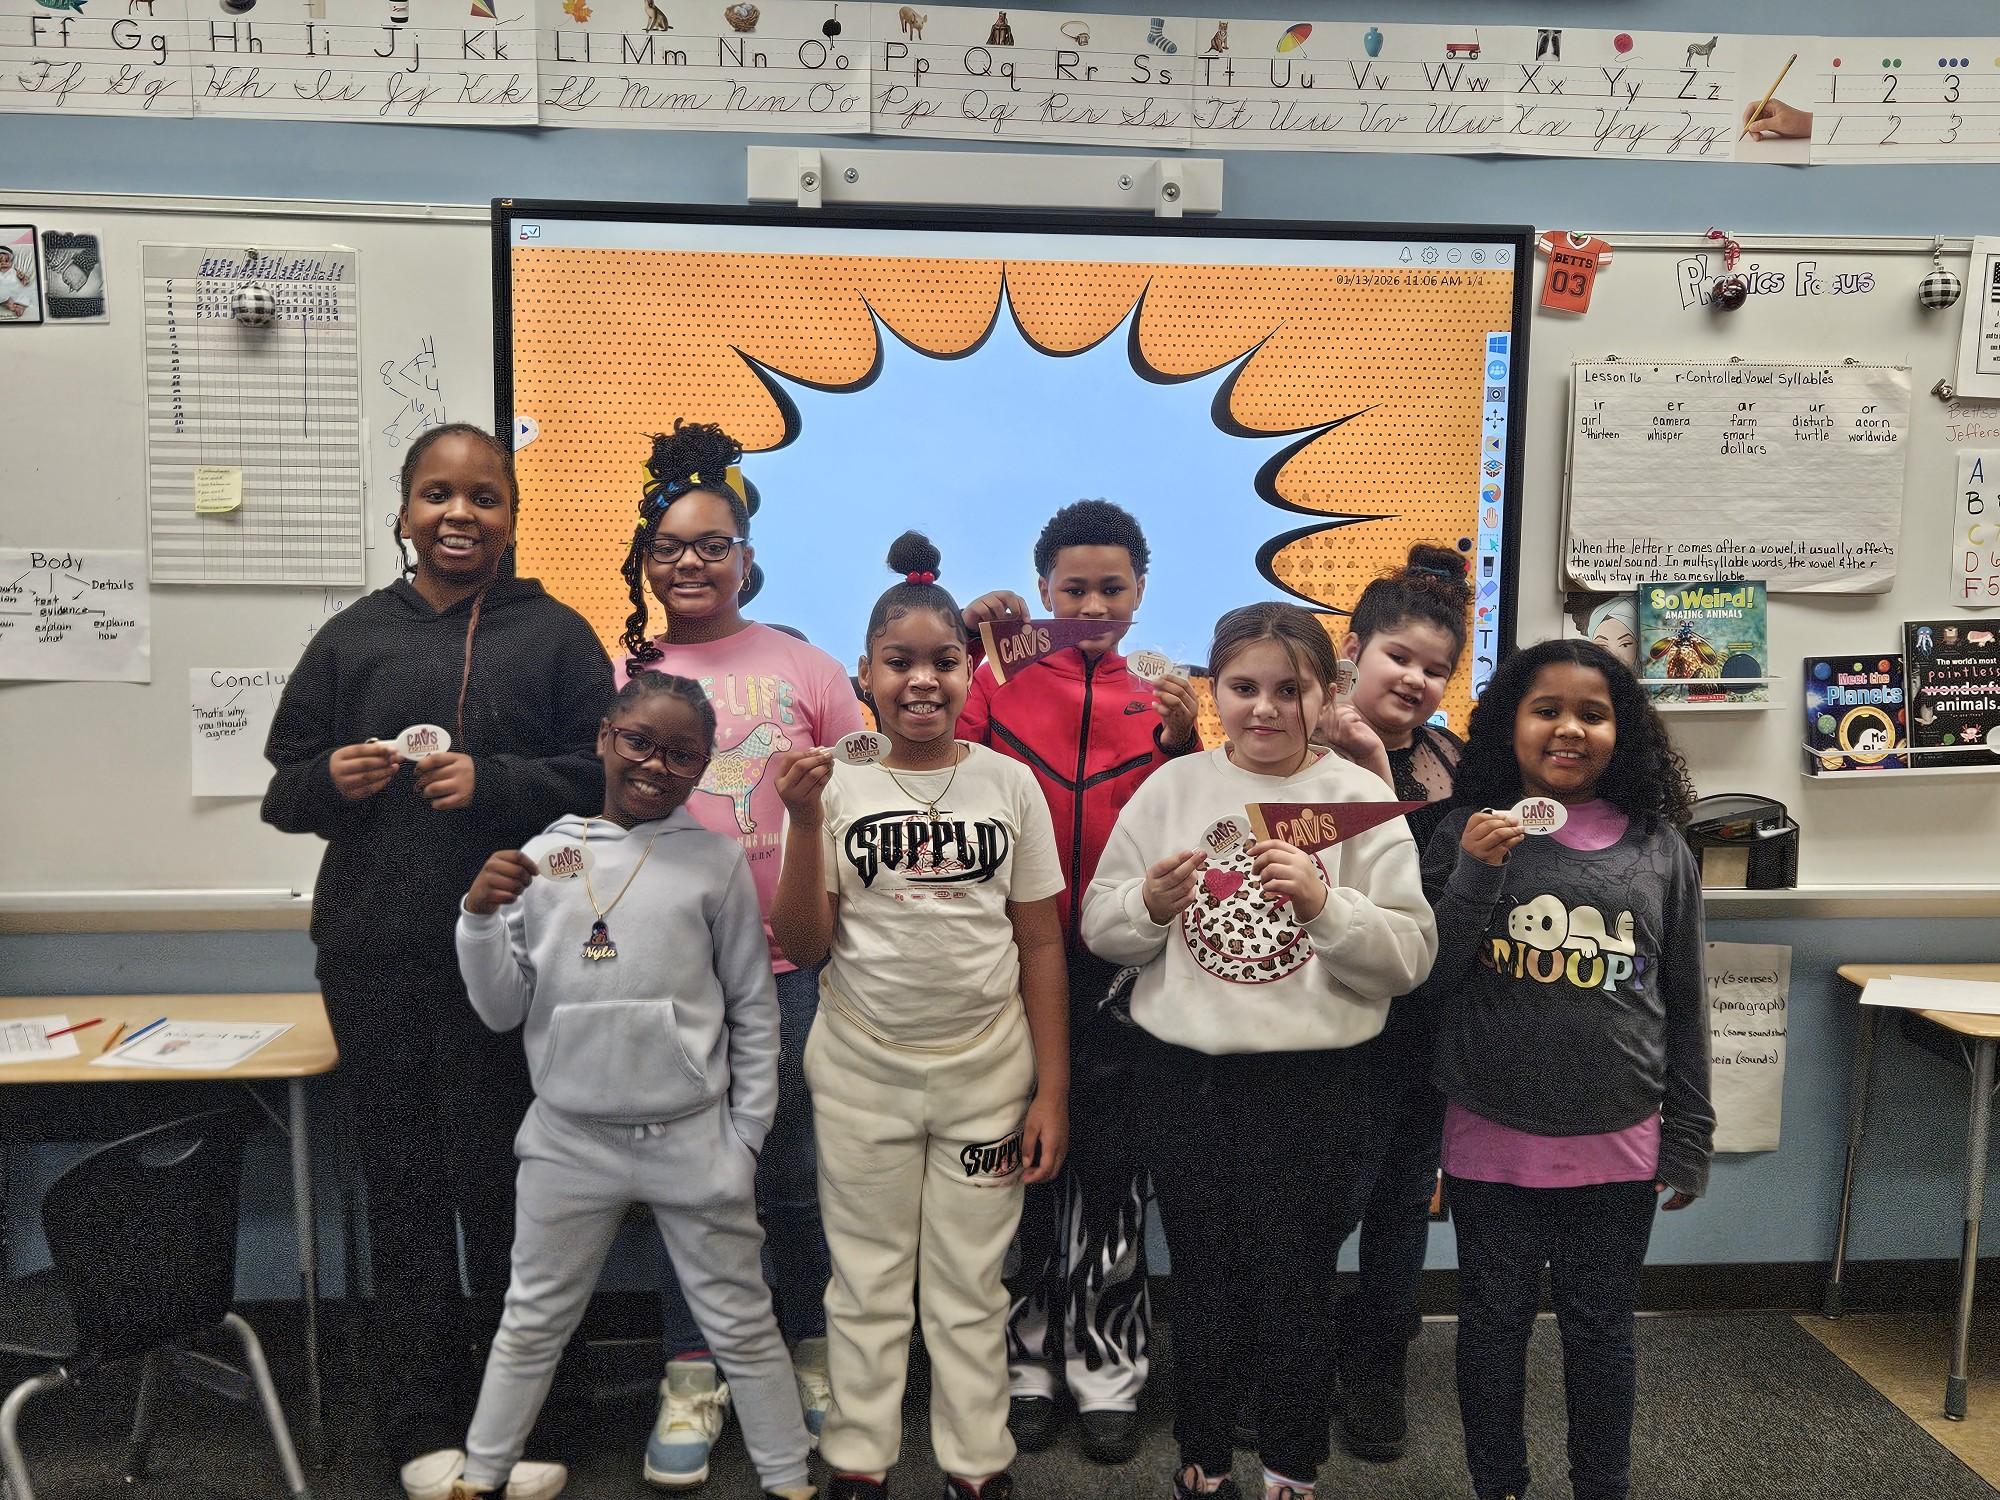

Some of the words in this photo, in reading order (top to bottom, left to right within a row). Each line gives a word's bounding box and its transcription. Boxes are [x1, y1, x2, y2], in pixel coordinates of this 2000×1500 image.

[1831, 74, 1837, 103] 1
[1882, 74, 1898, 103] 2
[1944, 74, 1961, 103] 3
[1828, 116, 1843, 144] 1
[1880, 115, 1902, 146] 2
[1940, 114, 1962, 144] 3
[1554, 252, 1593, 269] BETTS
[1336, 274, 1400, 286] 01/13/2026
[1406, 274, 1437, 286] 11:06
[1441, 275, 1461, 286] AM
[1467, 275, 1484, 287] 1/1
[1551, 269, 1587, 297] 03
[379, 360, 395, 386] 8
[1585, 369, 1626, 383] Lesson
[1629, 372, 1642, 383] 16
[1675, 370, 1743, 384] r-Controlled
[1744, 372, 1773, 384] Vowel
[1778, 373, 1834, 388] Syllables
[425, 374, 442, 401] 4
[410, 398, 425, 415] 16
[1594, 400, 1605, 410] ir
[1667, 401, 1685, 411] er
[1738, 402, 1756, 411] ar
[1809, 403, 1825, 412] ur
[1861, 405, 1877, 414] or
[1581, 413, 1601, 433] girl
[1652, 416, 1690, 426] camera
[1730, 414, 1757, 427] farm
[1792, 415, 1834, 427] disturb
[1855, 418, 1890, 428] acorn
[382, 423, 401, 447] 8
[1587, 428, 1620, 440] thirteen
[1647, 428, 1683, 443] whisper
[1723, 429, 1755, 440] smart
[1794, 428, 1830, 441] turtle
[1848, 430, 1897, 442] worldwide
[1720, 441, 1767, 455] dollars
[1968, 457, 1984, 485] A
[1965, 491, 1984, 515] B
[1967, 523, 1985, 546] C
[1571, 539, 1605, 554] When
[1606, 539, 1629, 553] the
[1631, 537, 1664, 554] letter
[1667, 543, 1674, 553] r
[1678, 543, 1713, 553] comes
[1716, 539, 1746, 554] after
[1798, 541, 1806, 554] it
[1809, 542, 1852, 559] usually
[1856, 542, 1894, 555] affects
[30, 552, 84, 572] Body
[1571, 555, 1590, 567] the
[1593, 555, 1622, 568] vowel
[1624, 556, 1661, 567] sound.
[1665, 555, 1679, 566] In
[1683, 555, 1749, 570] multisyllable
[1752, 556, 1787, 570] words,
[1788, 556, 1806, 568] the
[1809, 557, 1836, 568] vowel
[1847, 557, 1865, 569] the
[1965, 551, 1979, 573] D
[91, 579, 135, 590] Details
[1609, 569, 1632, 584] stay
[1636, 572, 1645, 581] in
[1650, 570, 1668, 581] the
[1965, 577, 1982, 598] F
[1651, 589, 1680, 609] So
[1681, 587, 1754, 609] Weird!
[1665, 610, 1703, 619] AMAZING
[1707, 610, 1742, 619] ANIMALS
[98, 631, 118, 640] how
[1000, 624, 1050, 664] CAVS
[1838, 673, 1868, 685] Meet
[1870, 672, 1890, 684] the
[726, 674, 794, 725] LIFE
[1827, 685, 1903, 706] Planets
[228, 706, 245, 718] why
[199, 723, 214, 732] you
[217, 718, 247, 728] should
[407, 728, 438, 747] CAVS
[845, 735, 878, 753] CAVS
[1872, 733, 1886, 742] Me
[1522, 801, 1555, 818] CAVS
[1206, 820, 1237, 847] CAVS
[1276, 808, 1338, 846] CAVS
[549, 847, 582, 868] CAVS
[581, 946, 617, 960] Nyla
[1713, 997, 1785, 1016] (paragraph)
[1736, 1049, 1778, 1065] (sounds)
